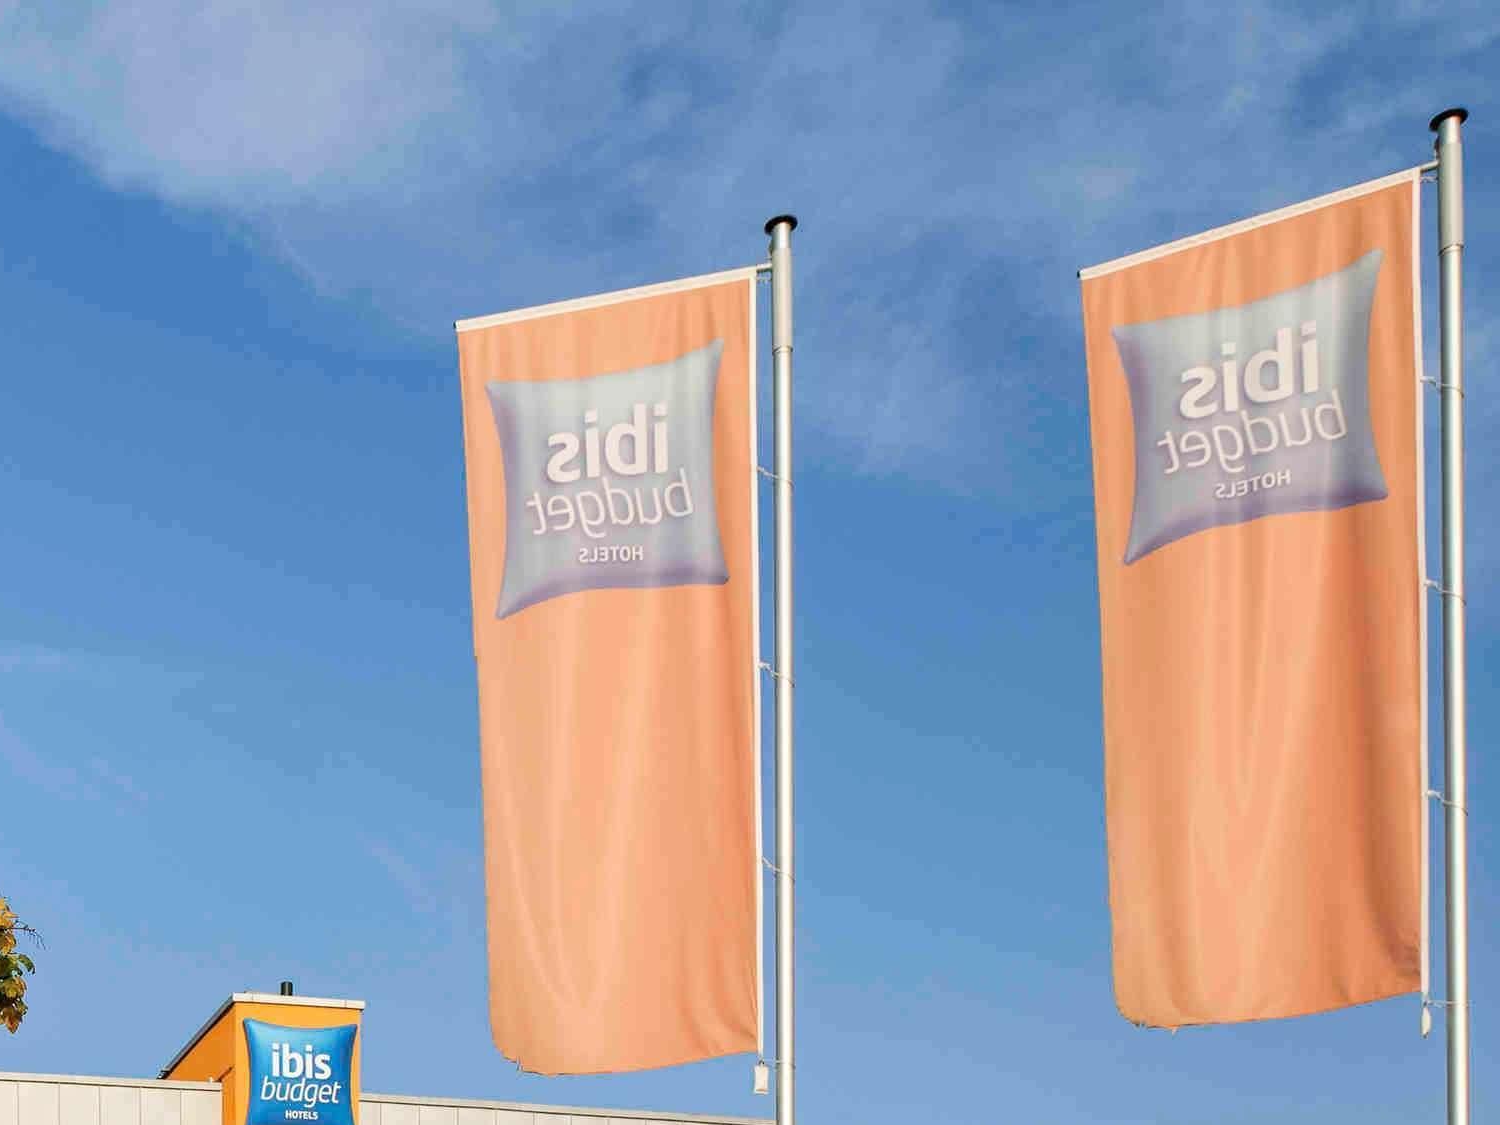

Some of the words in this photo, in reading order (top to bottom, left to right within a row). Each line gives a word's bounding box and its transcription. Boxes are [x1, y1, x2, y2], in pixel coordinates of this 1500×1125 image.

[271, 1042, 332, 1080] ibis
[260, 1075, 342, 1108] budget
[285, 1110, 319, 1120] HOTELS
